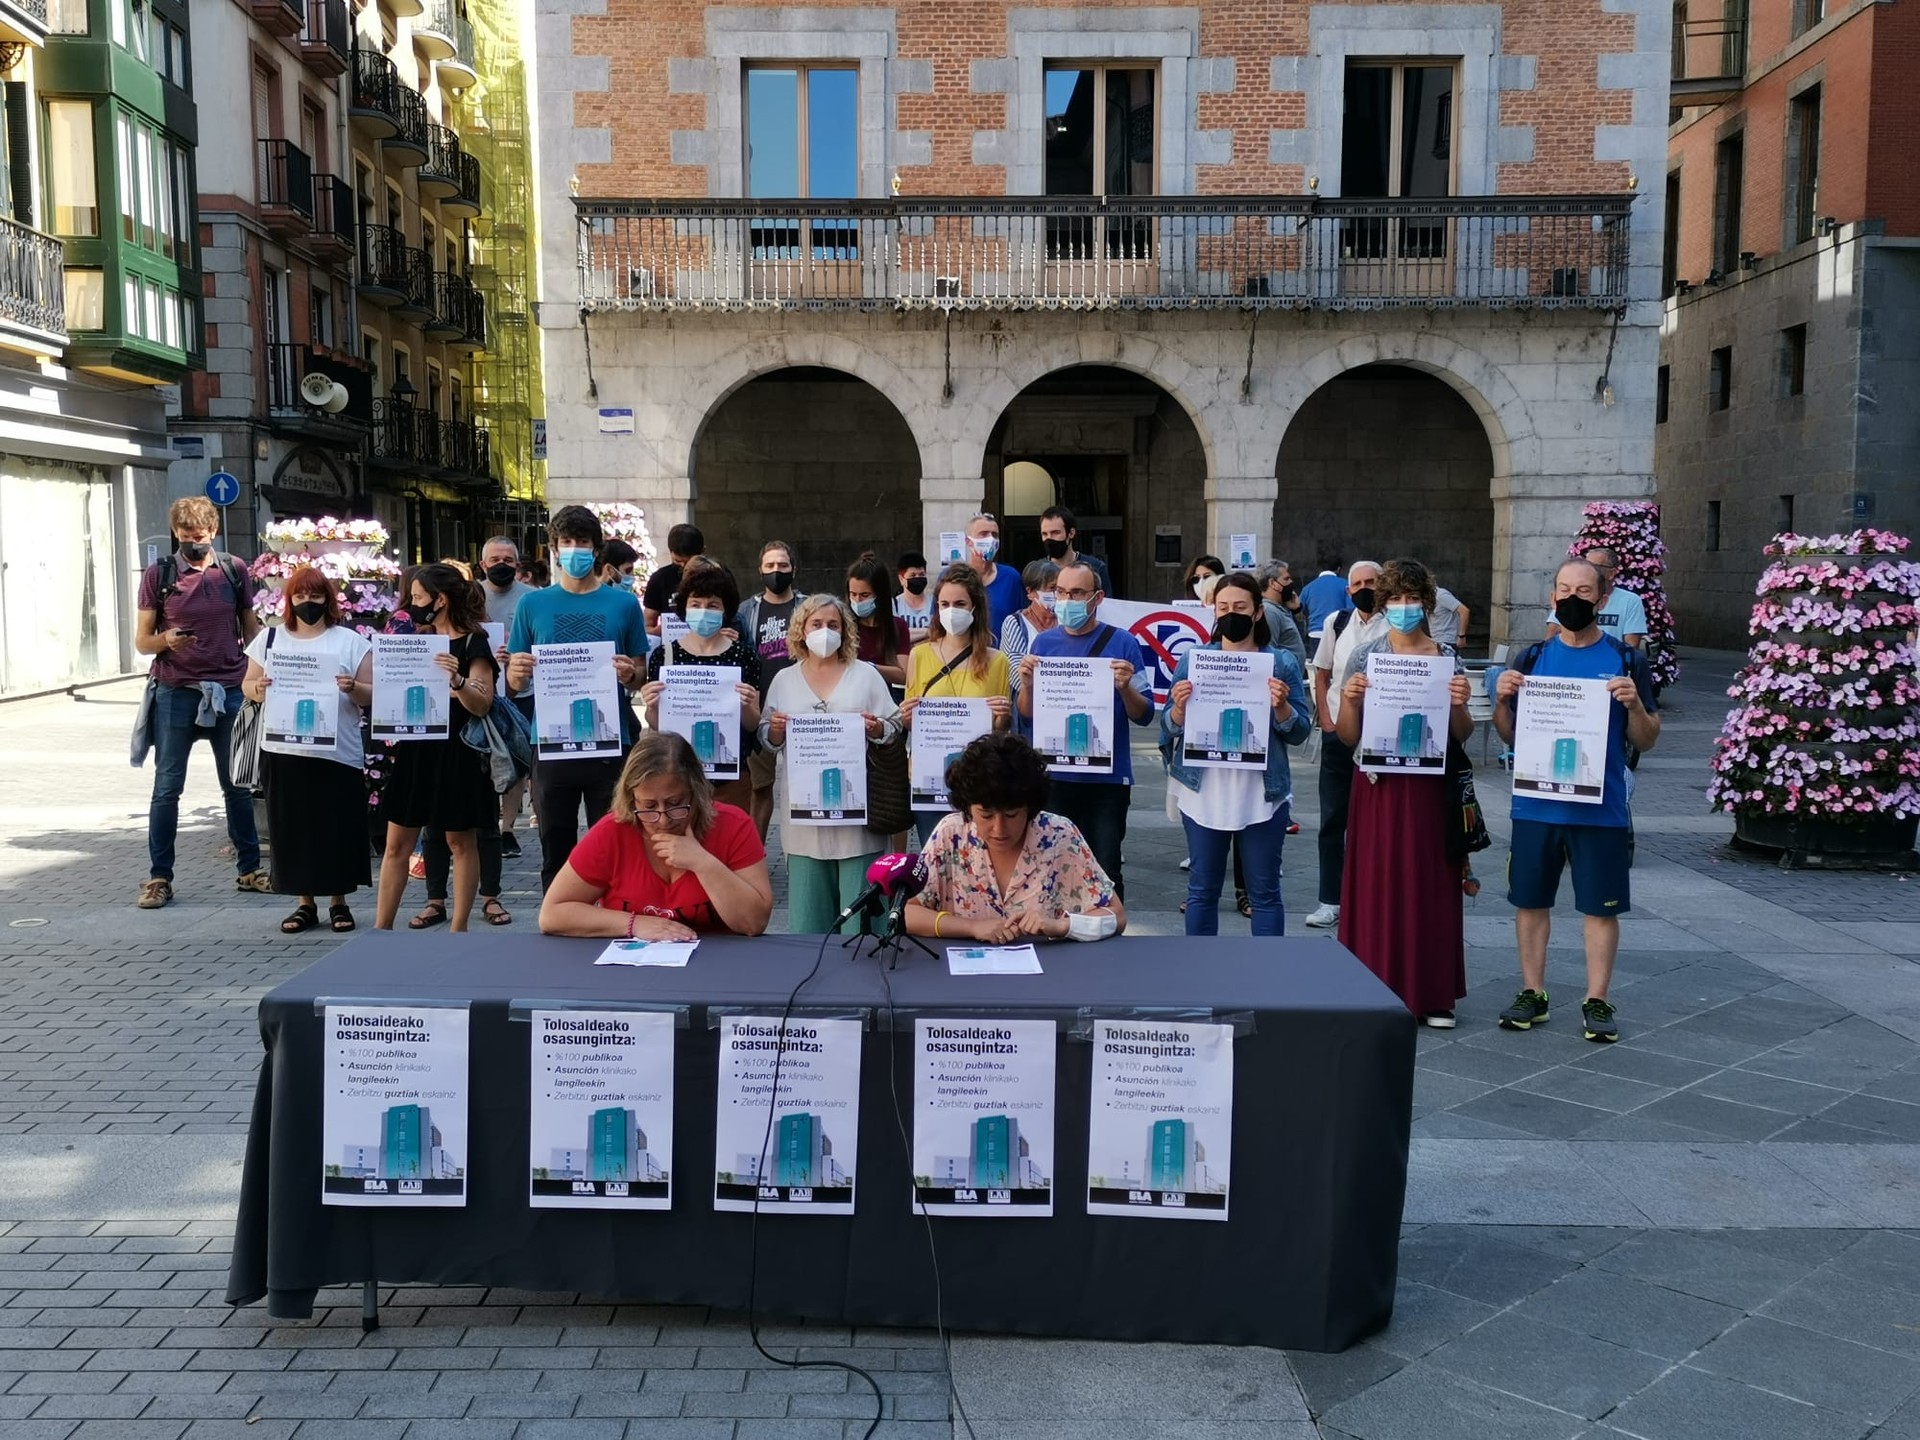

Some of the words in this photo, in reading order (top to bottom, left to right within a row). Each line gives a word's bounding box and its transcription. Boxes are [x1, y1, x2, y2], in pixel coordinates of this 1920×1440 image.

[538, 646, 589, 656] Tolosaldeako
[1196, 654, 1247, 663] Tolosaldeako
[1375, 658, 1427, 667] Tolosaldeako
[1526, 680, 1581, 690] Tolosaldeako
[337, 1014, 424, 1028] Tolosaldeako
[543, 1018, 629, 1032] Tolosaldeako
[337, 1028, 430, 1044] osasungintza:
[732, 1024, 816, 1038] Tolosaldeako
[926, 1026, 1011, 1039] Tolosaldeako
[1105, 1028, 1189, 1042] Tolosaldeako
[543, 1033, 635, 1048] osasungintza:
[731, 1039, 823, 1054] osasungintza:
[926, 1041, 1017, 1055] osasungintza:
[1104, 1042, 1195, 1058] osasungintza:
[376, 1049, 417, 1059] publikoa
[582, 1053, 622, 1063] publikoa
[348, 1061, 393, 1070] Asunción
[554, 1065, 598, 1074] Asunción
[964, 1062, 1005, 1071] publikoa
[1142, 1063, 1182, 1074] publikoa
[348, 1074, 399, 1084] langileekin
[937, 1073, 981, 1082] Asunción
[1115, 1074, 1158, 1084] Asunción
[554, 1078, 605, 1088] langileekin
[385, 1089, 420, 1099] guztiak
[937, 1086, 987, 1096] langileekin
[1114, 1087, 1164, 1098] langileekin
[591, 1092, 626, 1102] guztiak
[777, 1098, 812, 1108] guztiak
[973, 1100, 1008, 1110] guztiak
[1150, 1102, 1184, 1113] guztiak
